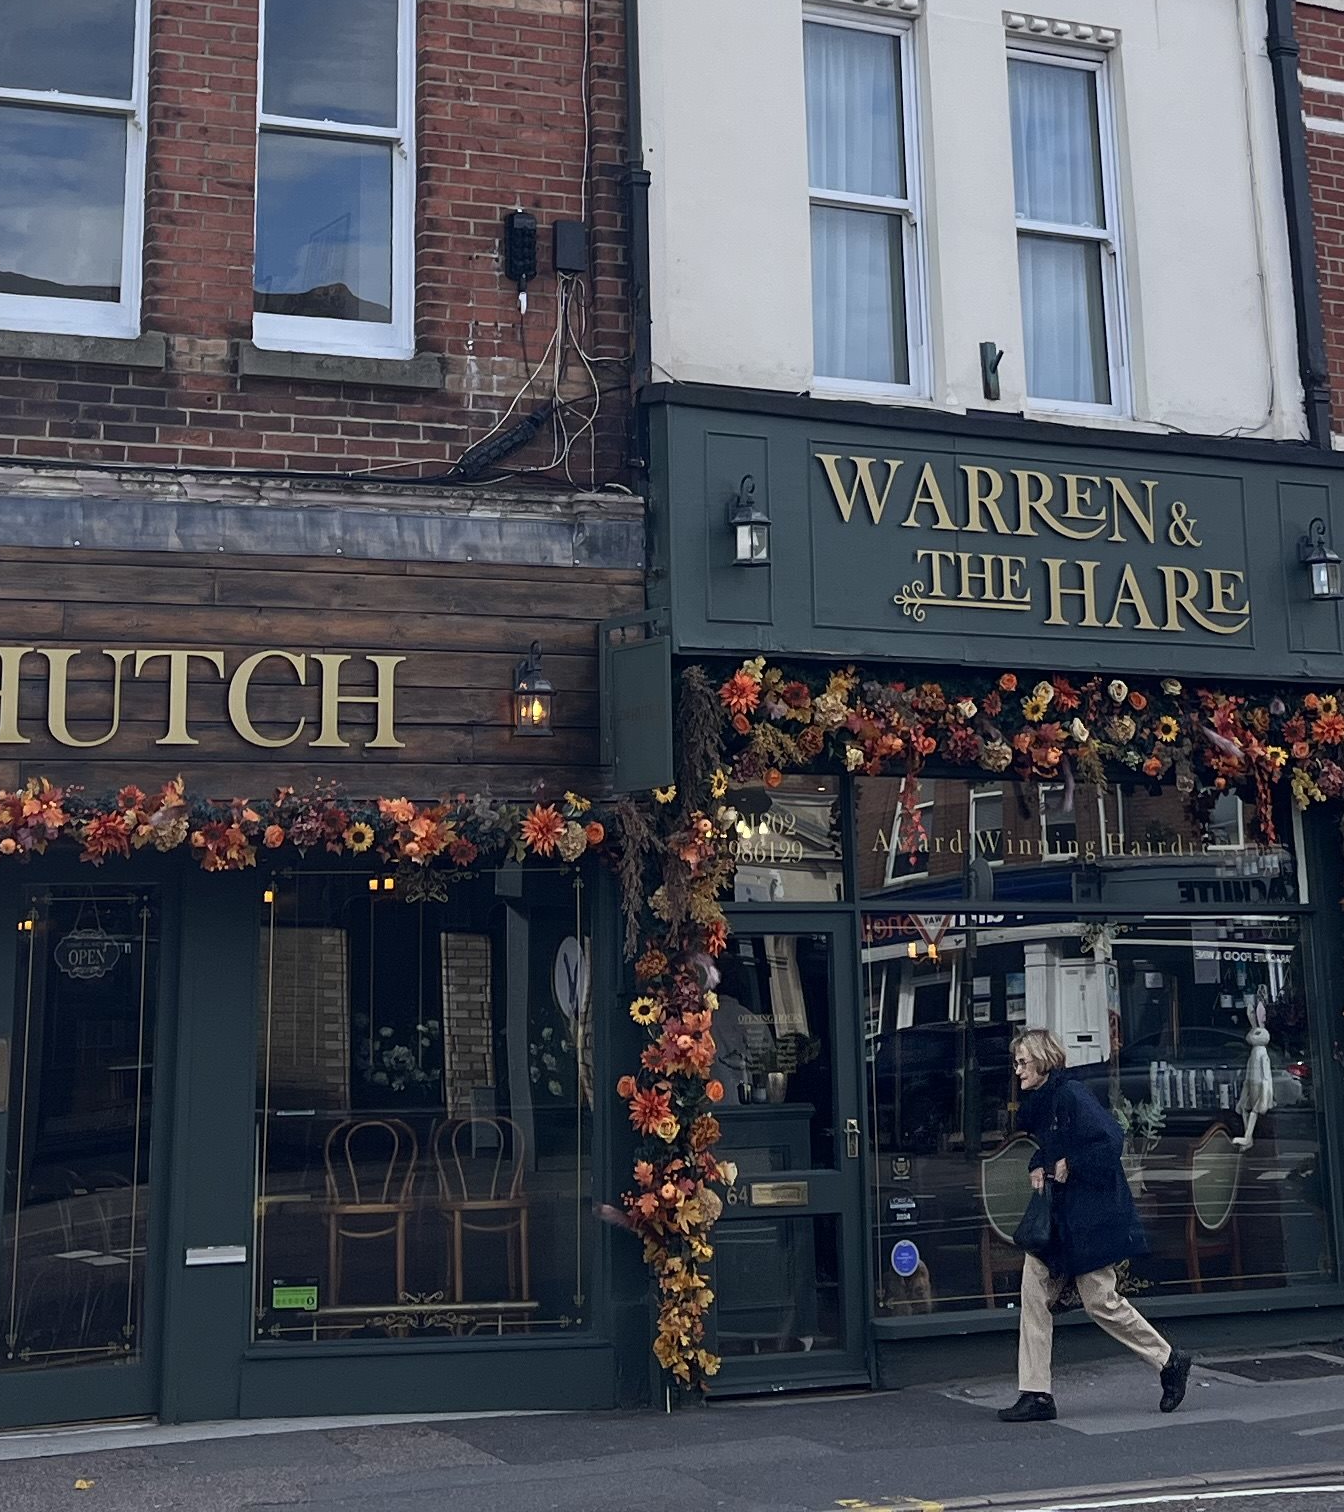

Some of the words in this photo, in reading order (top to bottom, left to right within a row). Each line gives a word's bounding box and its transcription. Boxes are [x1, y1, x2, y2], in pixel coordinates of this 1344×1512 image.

[816, 453, 1159, 544] WARREN
[1168, 501, 1203, 547] &
[917, 549, 1031, 603] THE
[1042, 556, 1251, 635] HARE
[735, 812, 796, 836] 01202
[729, 840, 804, 864] 986129
[976, 829, 1097, 863] Winning
[68, 949, 105, 965] OPEN
[727, 1186, 748, 1206] 64
